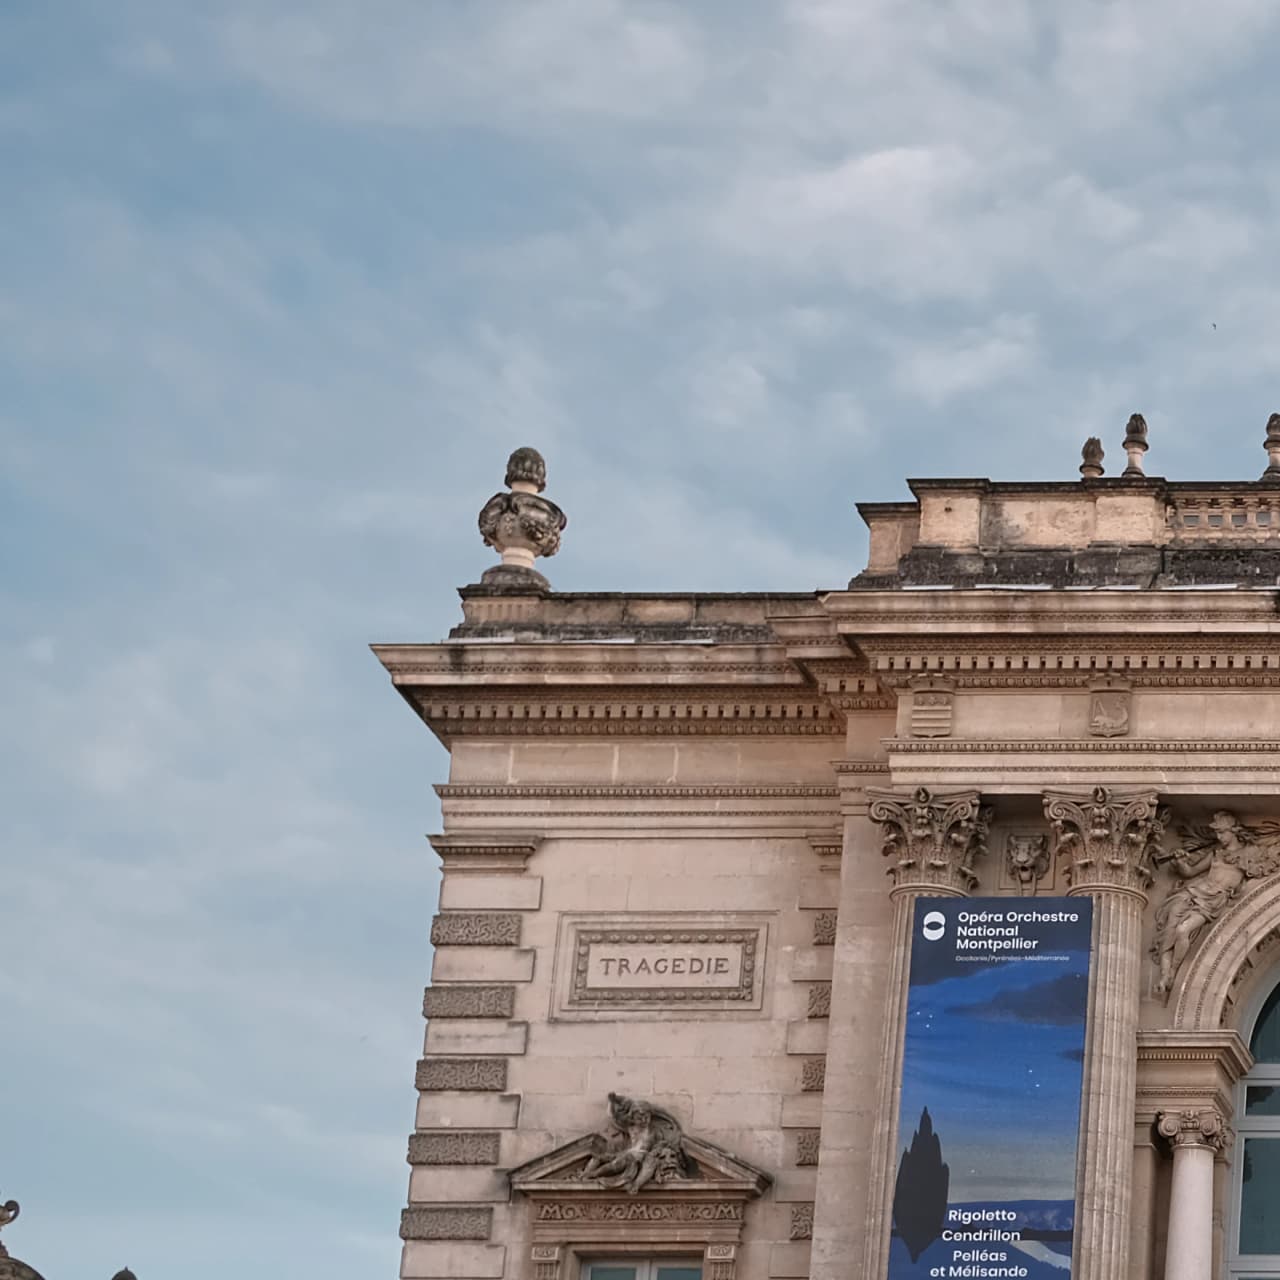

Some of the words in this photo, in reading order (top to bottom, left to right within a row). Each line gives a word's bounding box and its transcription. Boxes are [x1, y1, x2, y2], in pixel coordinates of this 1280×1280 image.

[958, 911, 1003, 925] Opéra
[1006, 911, 1079, 923] Orchestre
[957, 925, 1019, 937] National
[956, 938, 1038, 953] Montpellier
[600, 958, 729, 976] TRAGEDIE
[948, 1209, 1017, 1224] Rigoletto
[941, 1229, 1021, 1242] Cendrillon
[953, 1249, 1007, 1263] Pelléas
[930, 1266, 948, 1278] et
[949, 1264, 1028, 1278] Mélisande
